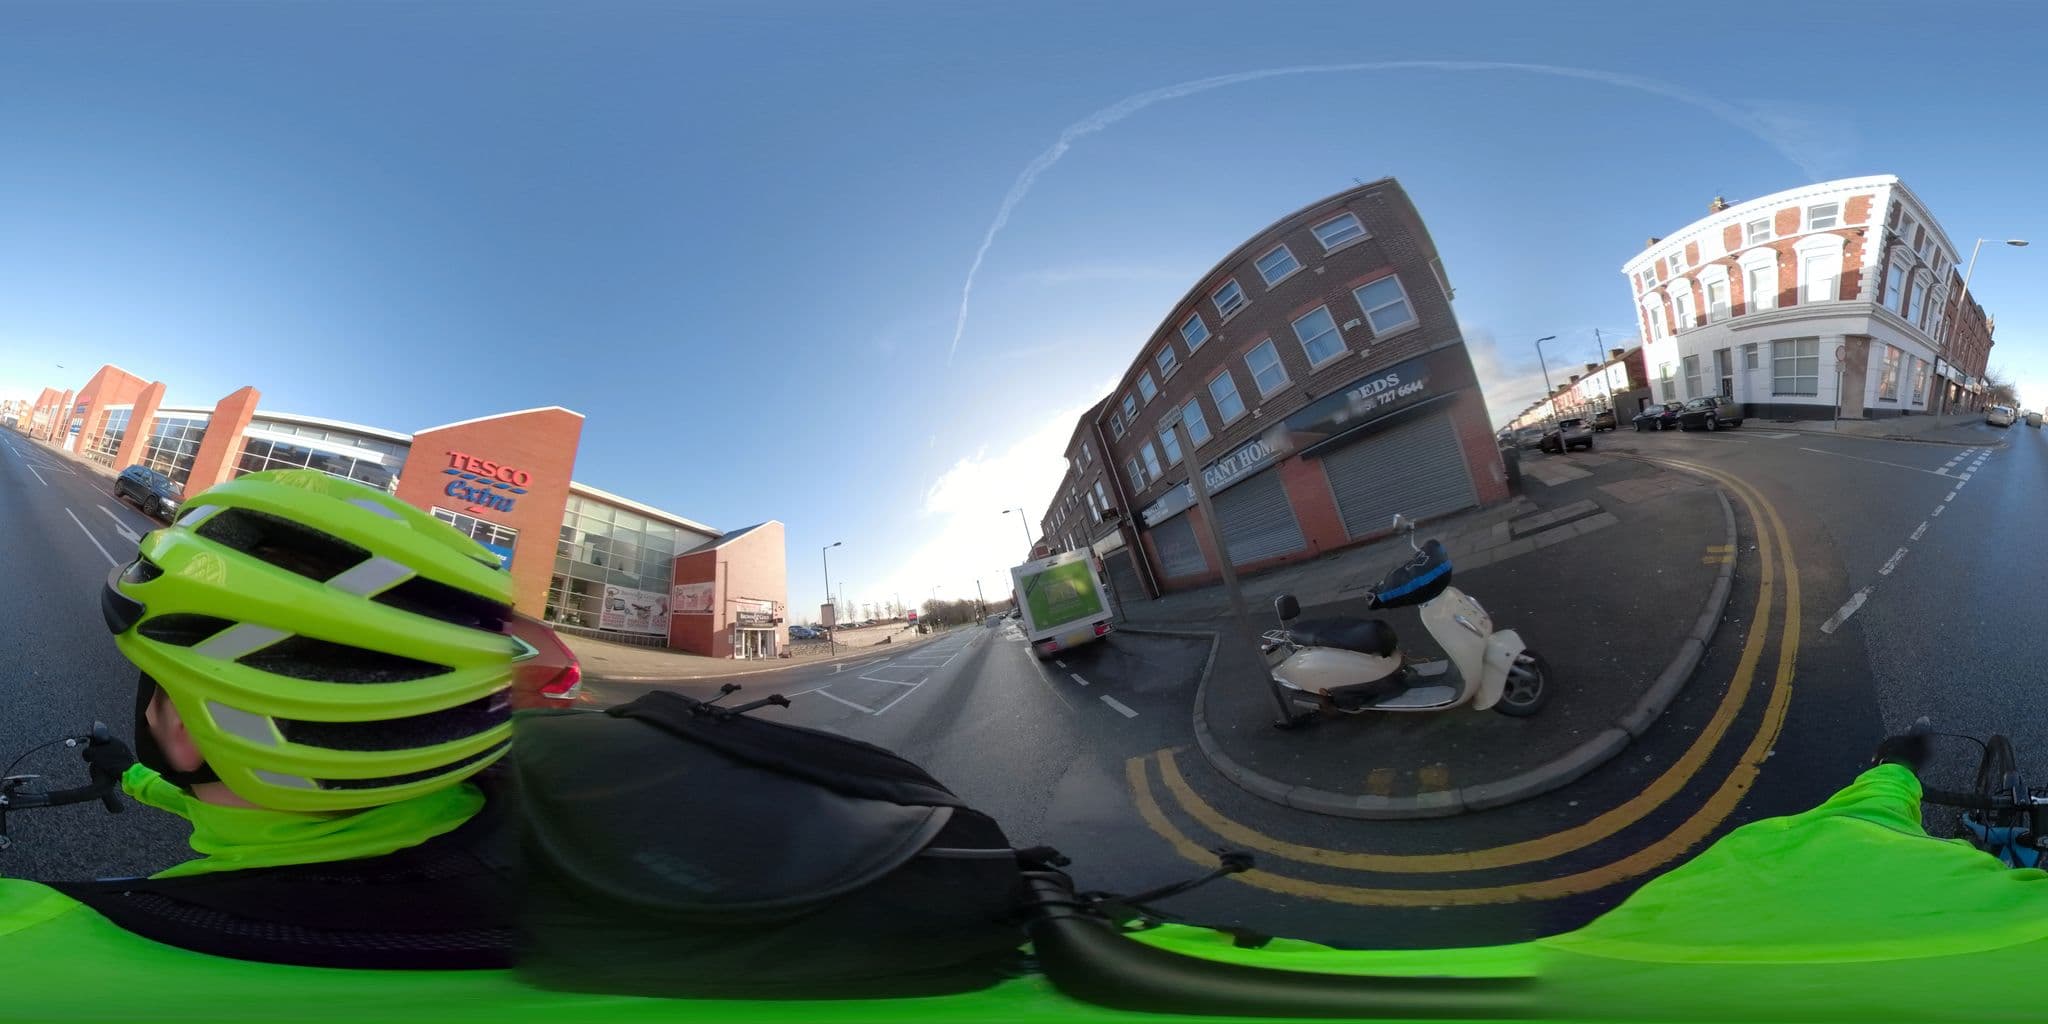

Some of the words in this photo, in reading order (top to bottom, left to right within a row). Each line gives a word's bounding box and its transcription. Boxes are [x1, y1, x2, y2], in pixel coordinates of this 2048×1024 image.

[1378, 390, 1397, 405] 727
[1398, 380, 1424, 397] 6644
[446, 451, 533, 487] TESCO
[1185, 457, 1237, 503] EGANT
[445, 480, 515, 512] extra
